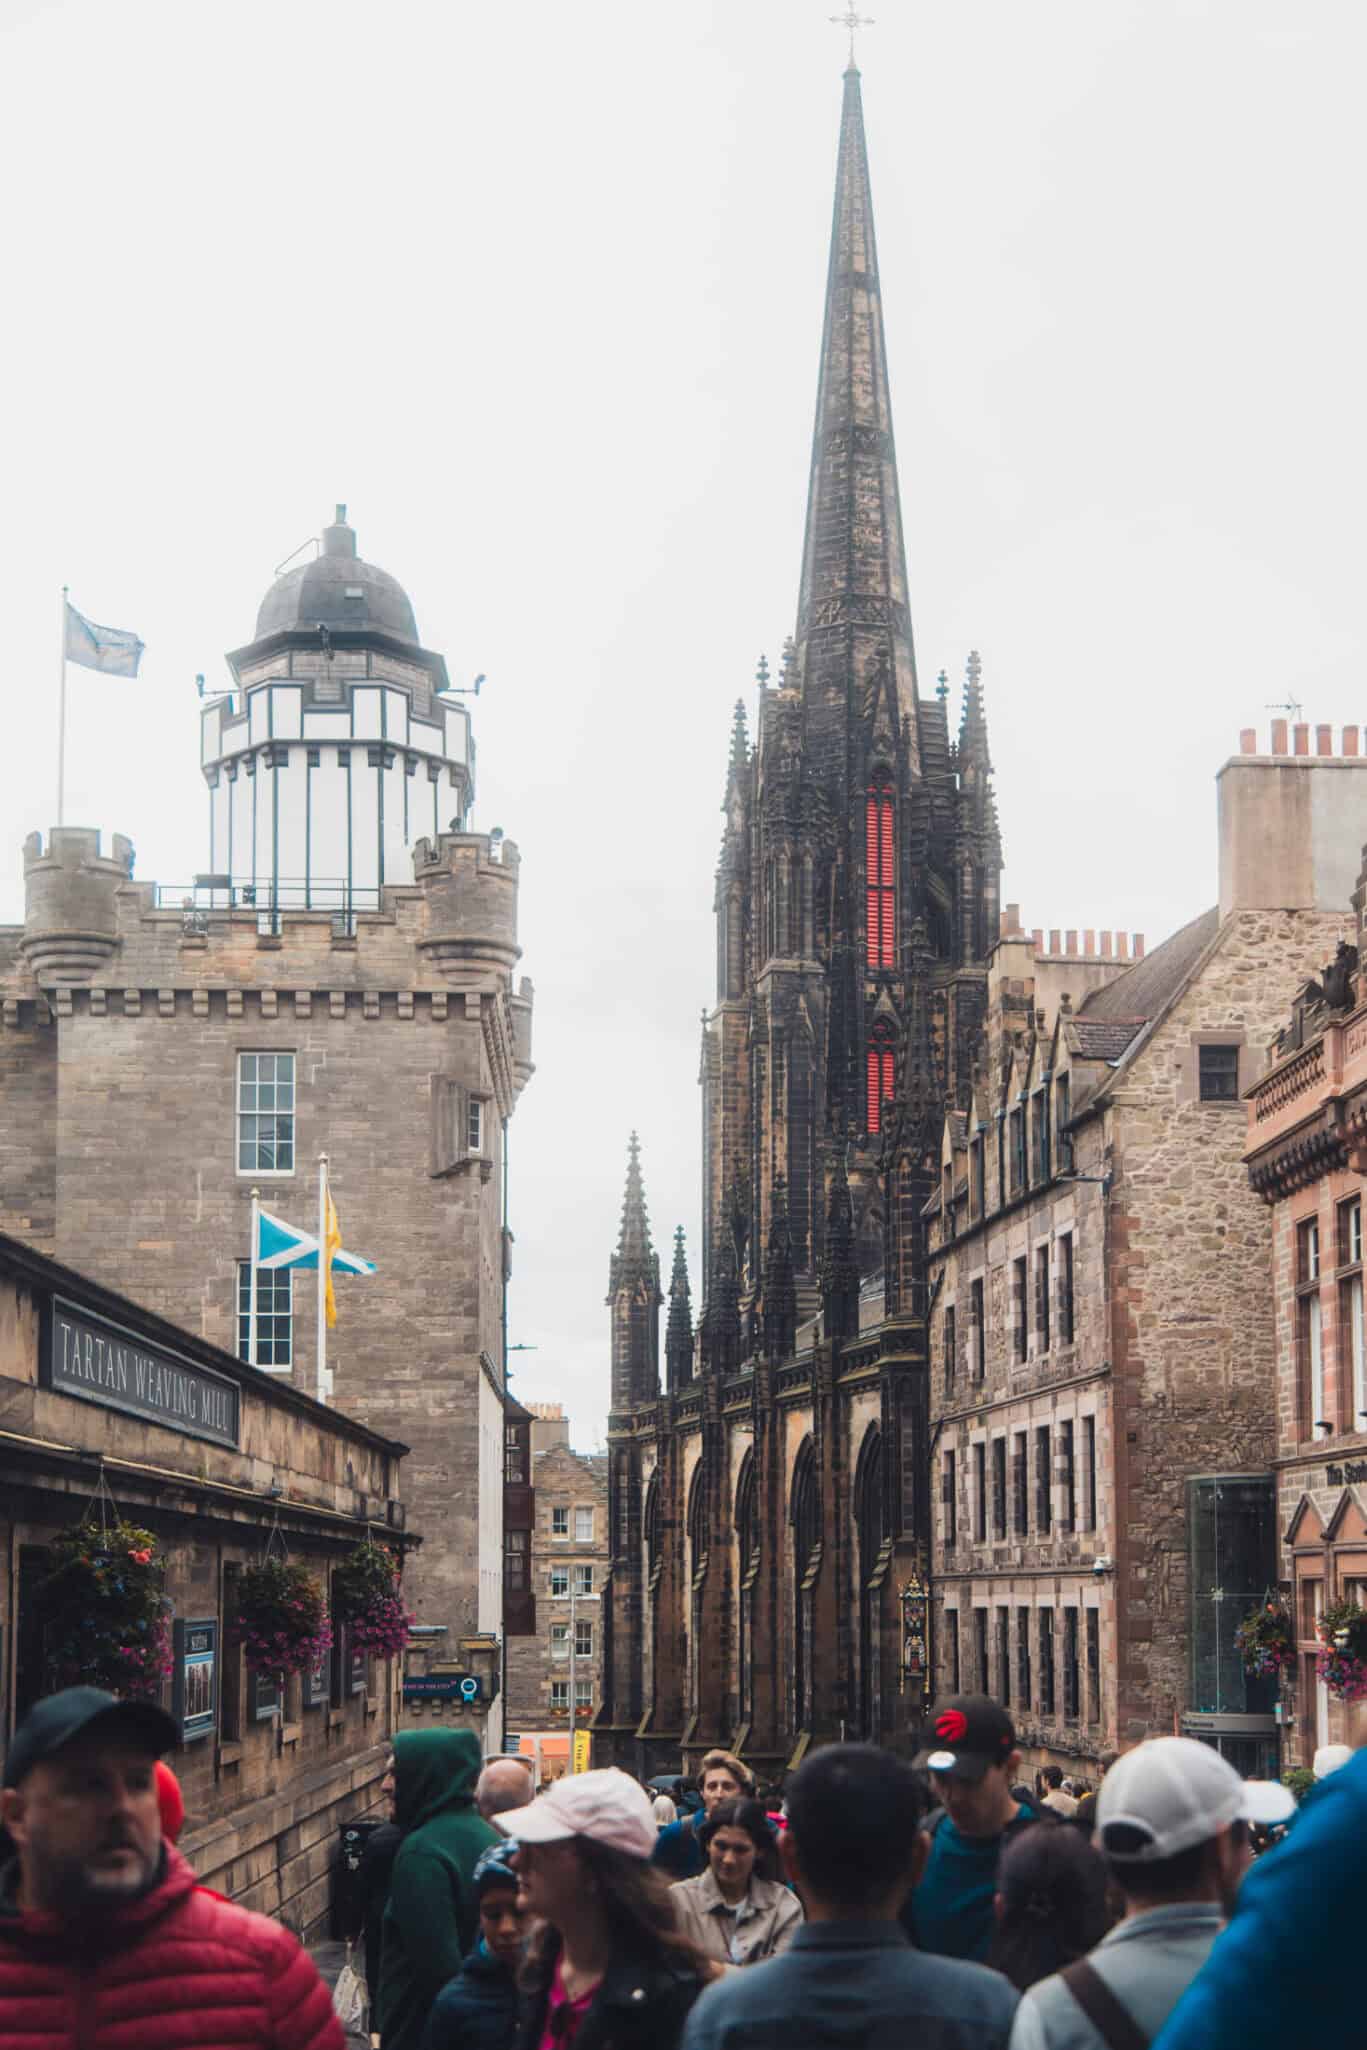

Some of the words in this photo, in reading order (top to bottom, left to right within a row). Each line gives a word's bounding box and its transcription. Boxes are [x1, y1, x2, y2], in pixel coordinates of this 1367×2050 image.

[61, 1322, 127, 1392] TARTAN
[133, 1354, 197, 1419] WEAVING
[201, 1386, 228, 1432] MILL
